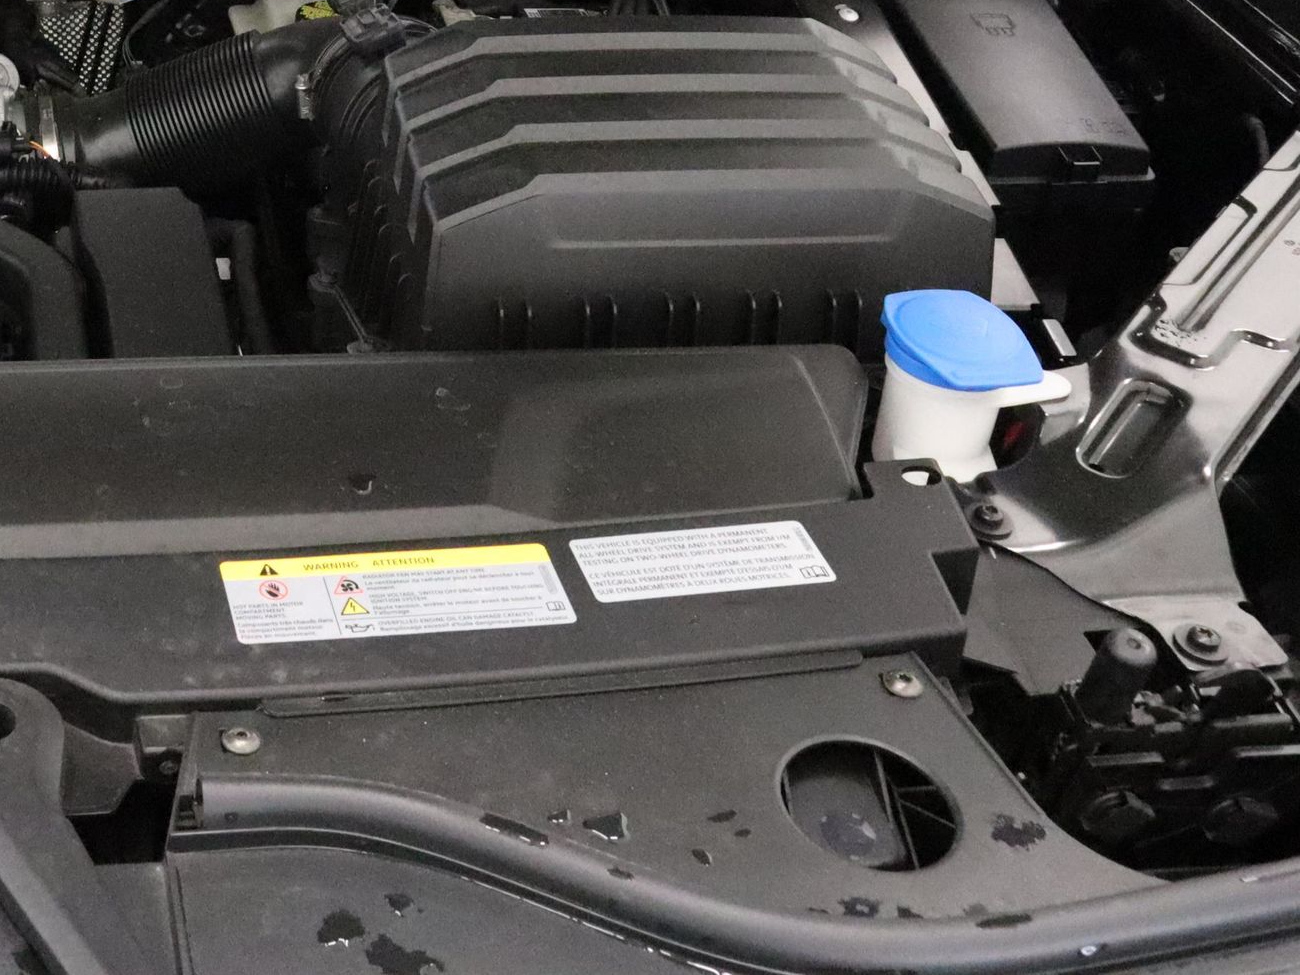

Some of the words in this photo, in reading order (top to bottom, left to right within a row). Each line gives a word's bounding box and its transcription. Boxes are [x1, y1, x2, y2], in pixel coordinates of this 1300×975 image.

[595, 541, 629, 549] VEHICLE
[641, 535, 684, 545] EQUIPPED
[685, 533, 709, 541] WITH
[717, 528, 768, 538] PERMANENT
[627, 546, 652, 554] DRIVE
[654, 543, 686, 552] SYSTEM
[718, 537, 749, 546] EXEMPT
[751, 535, 776, 543] FROM
[303, 561, 359, 570] WARNING
[372, 557, 435, 566] ATTENTION
[583, 557, 620, 566] TESTING
[620, 556, 634, 564] ON
[690, 548, 715, 556] DRIVE
